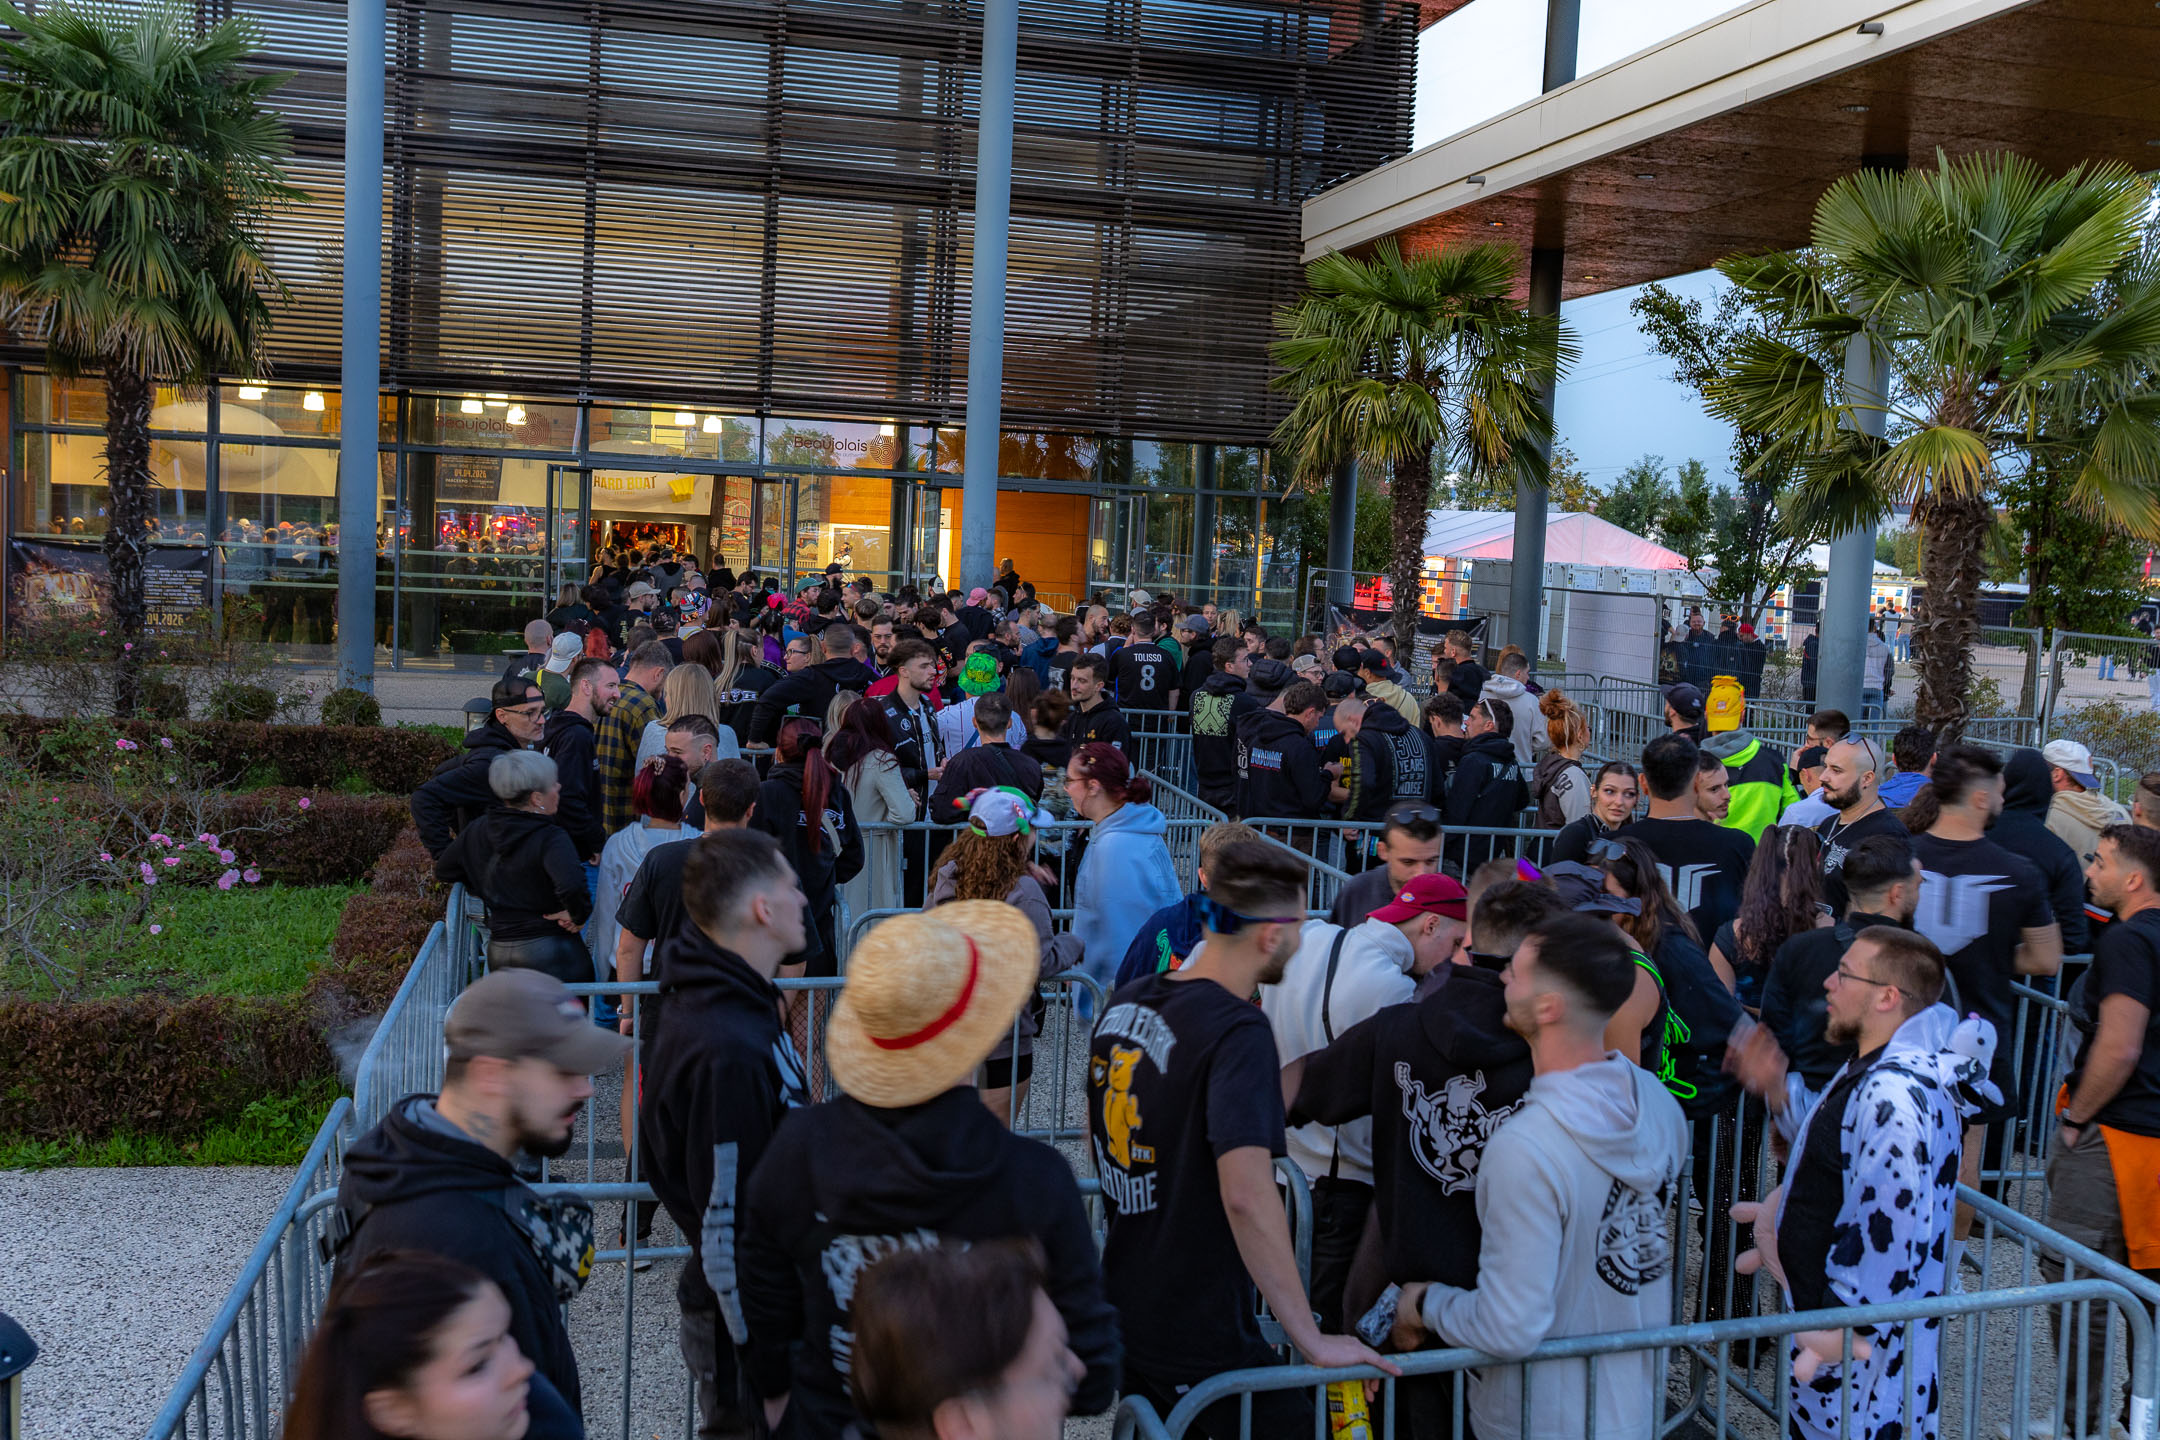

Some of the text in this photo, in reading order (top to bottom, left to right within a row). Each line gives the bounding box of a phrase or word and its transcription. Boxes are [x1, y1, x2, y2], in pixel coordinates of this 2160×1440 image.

[434, 416, 513, 433] Beaujolais
[794, 435, 868, 454] Beaujolais
[593, 475, 656, 490] HARD BOAT
[1133, 653, 1162, 662] TOLISSO
[1140, 664, 1155, 691] 8
[1399, 758, 1425, 773] YEARS
[1398, 781, 1423, 795] NOISE
